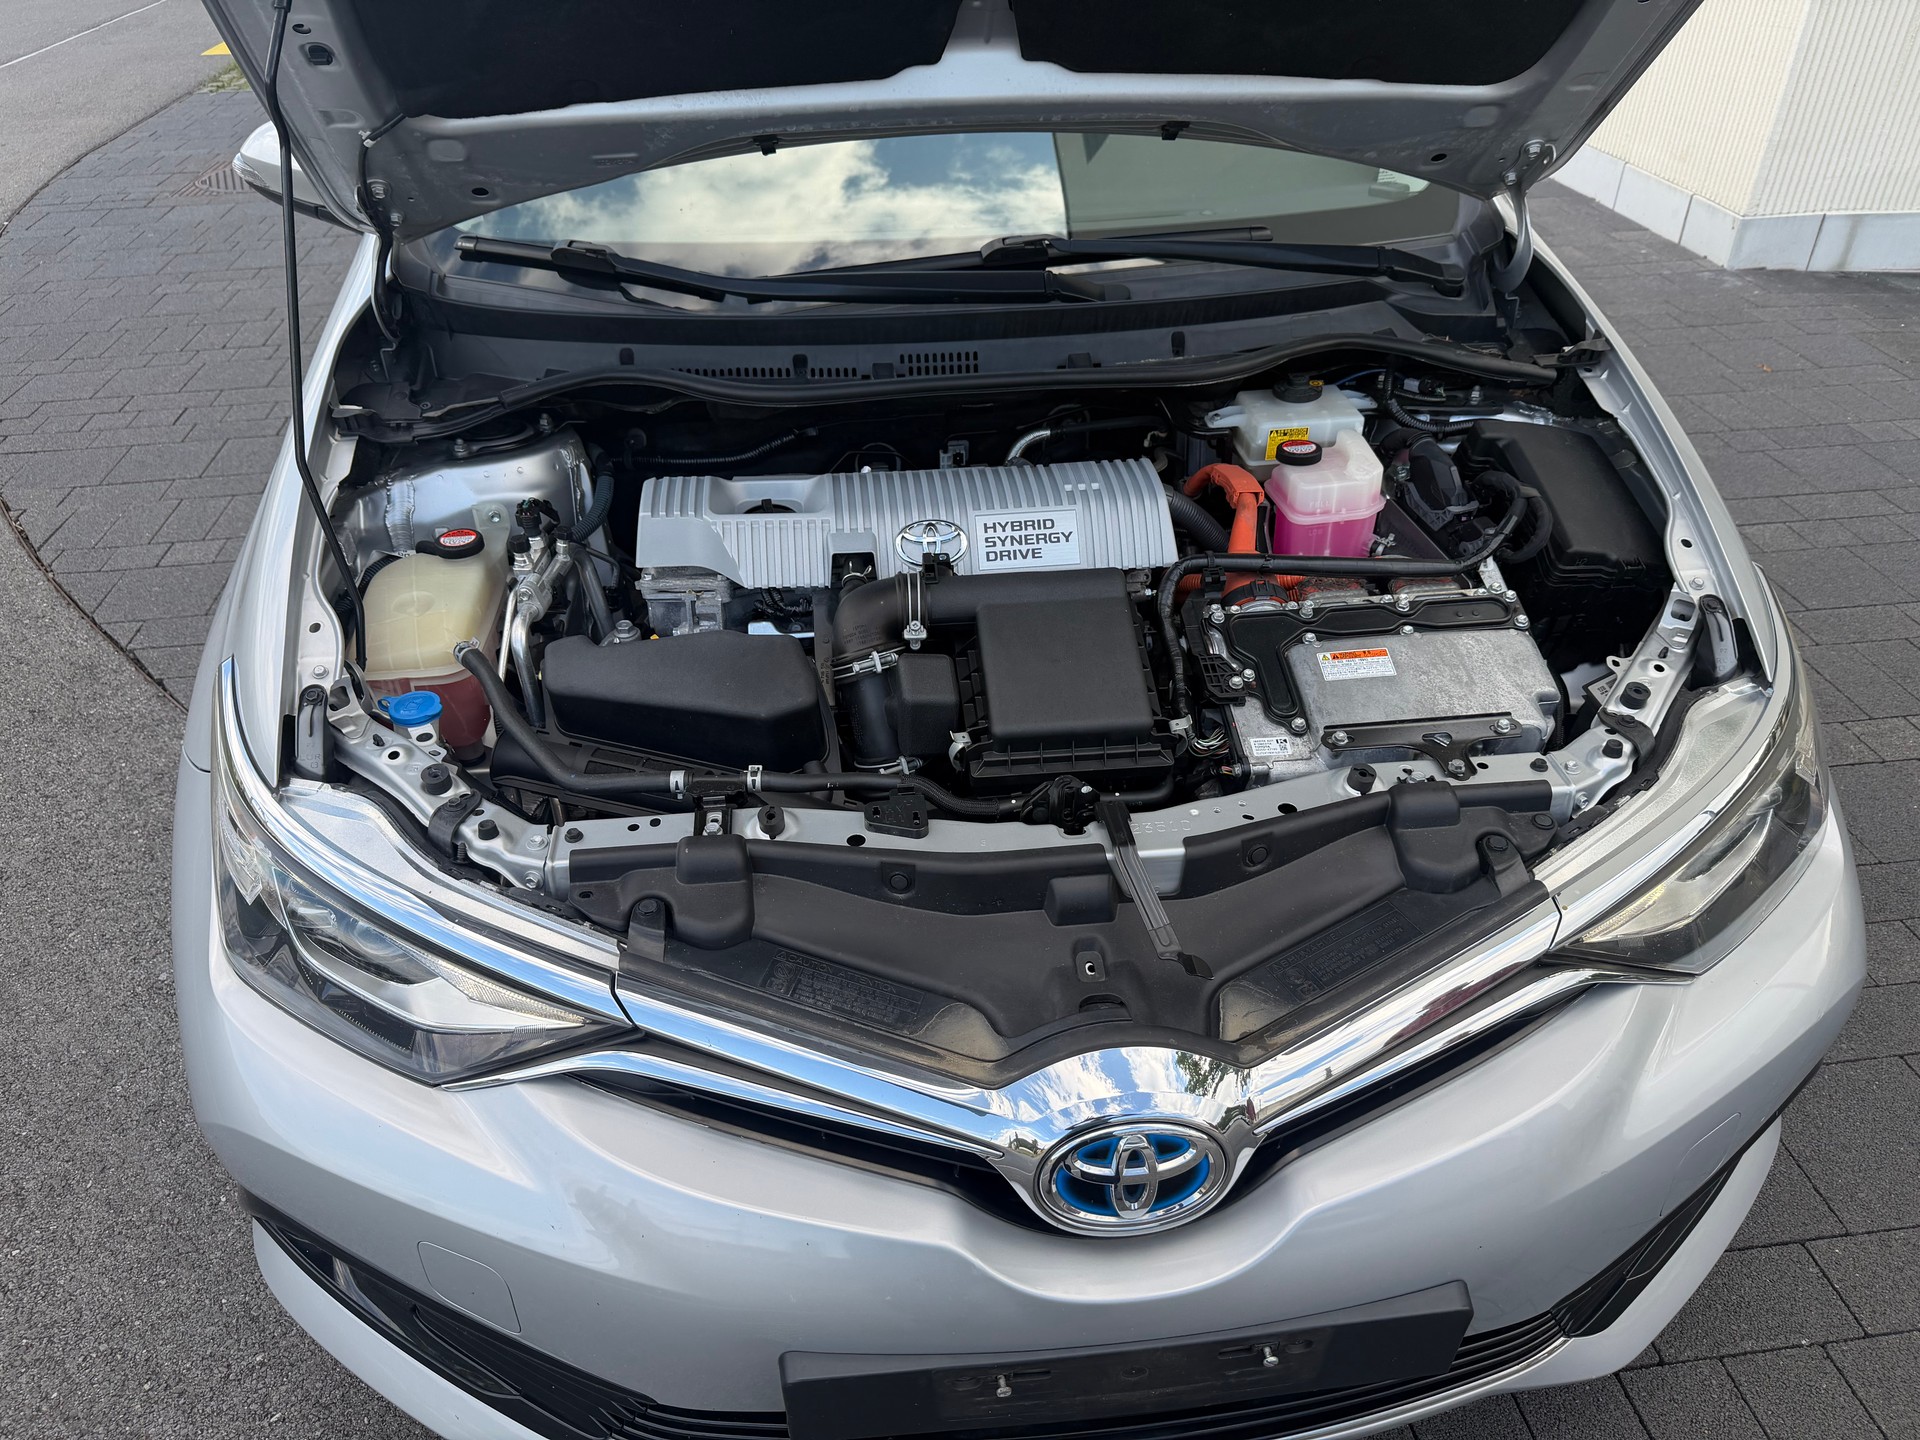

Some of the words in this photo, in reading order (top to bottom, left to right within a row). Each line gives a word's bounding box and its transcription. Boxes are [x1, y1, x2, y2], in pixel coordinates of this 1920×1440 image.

[983, 518, 1055, 533] HYBRID
[985, 531, 1073, 548] SYNERGY
[986, 548, 1042, 562] DRIVE
[788, 954, 832, 975] CAUTION
